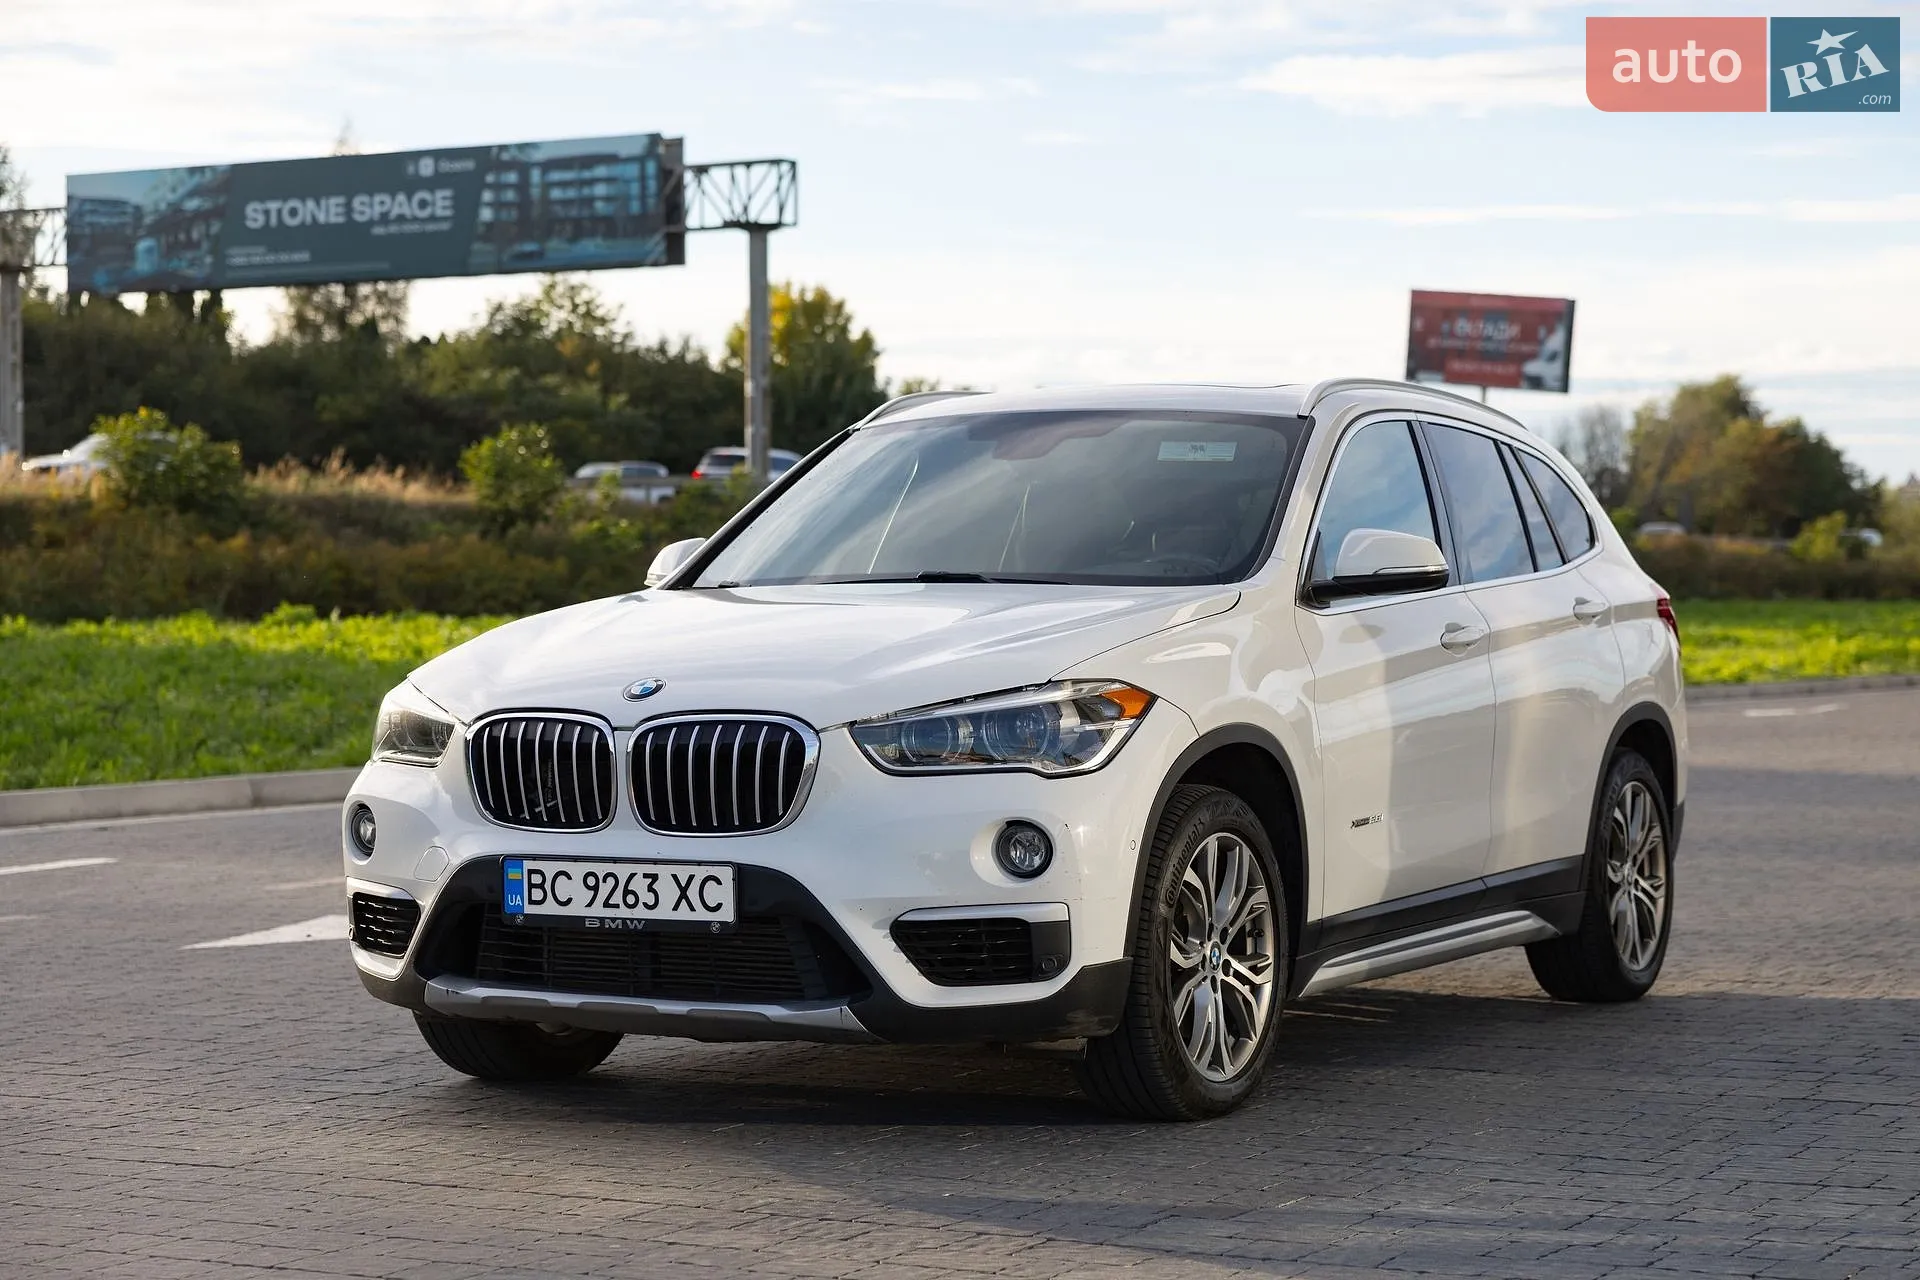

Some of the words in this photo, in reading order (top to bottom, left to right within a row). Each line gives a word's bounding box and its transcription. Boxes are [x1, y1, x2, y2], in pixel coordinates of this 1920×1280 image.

[244, 195, 347, 229] STONE
[350, 188, 455, 223] SPACE
[508, 894, 523, 906] UA
[527, 868, 573, 907] BC
[582, 870, 660, 911] 9263
[671, 873, 724, 913] XC
[585, 918, 646, 930] BMW
